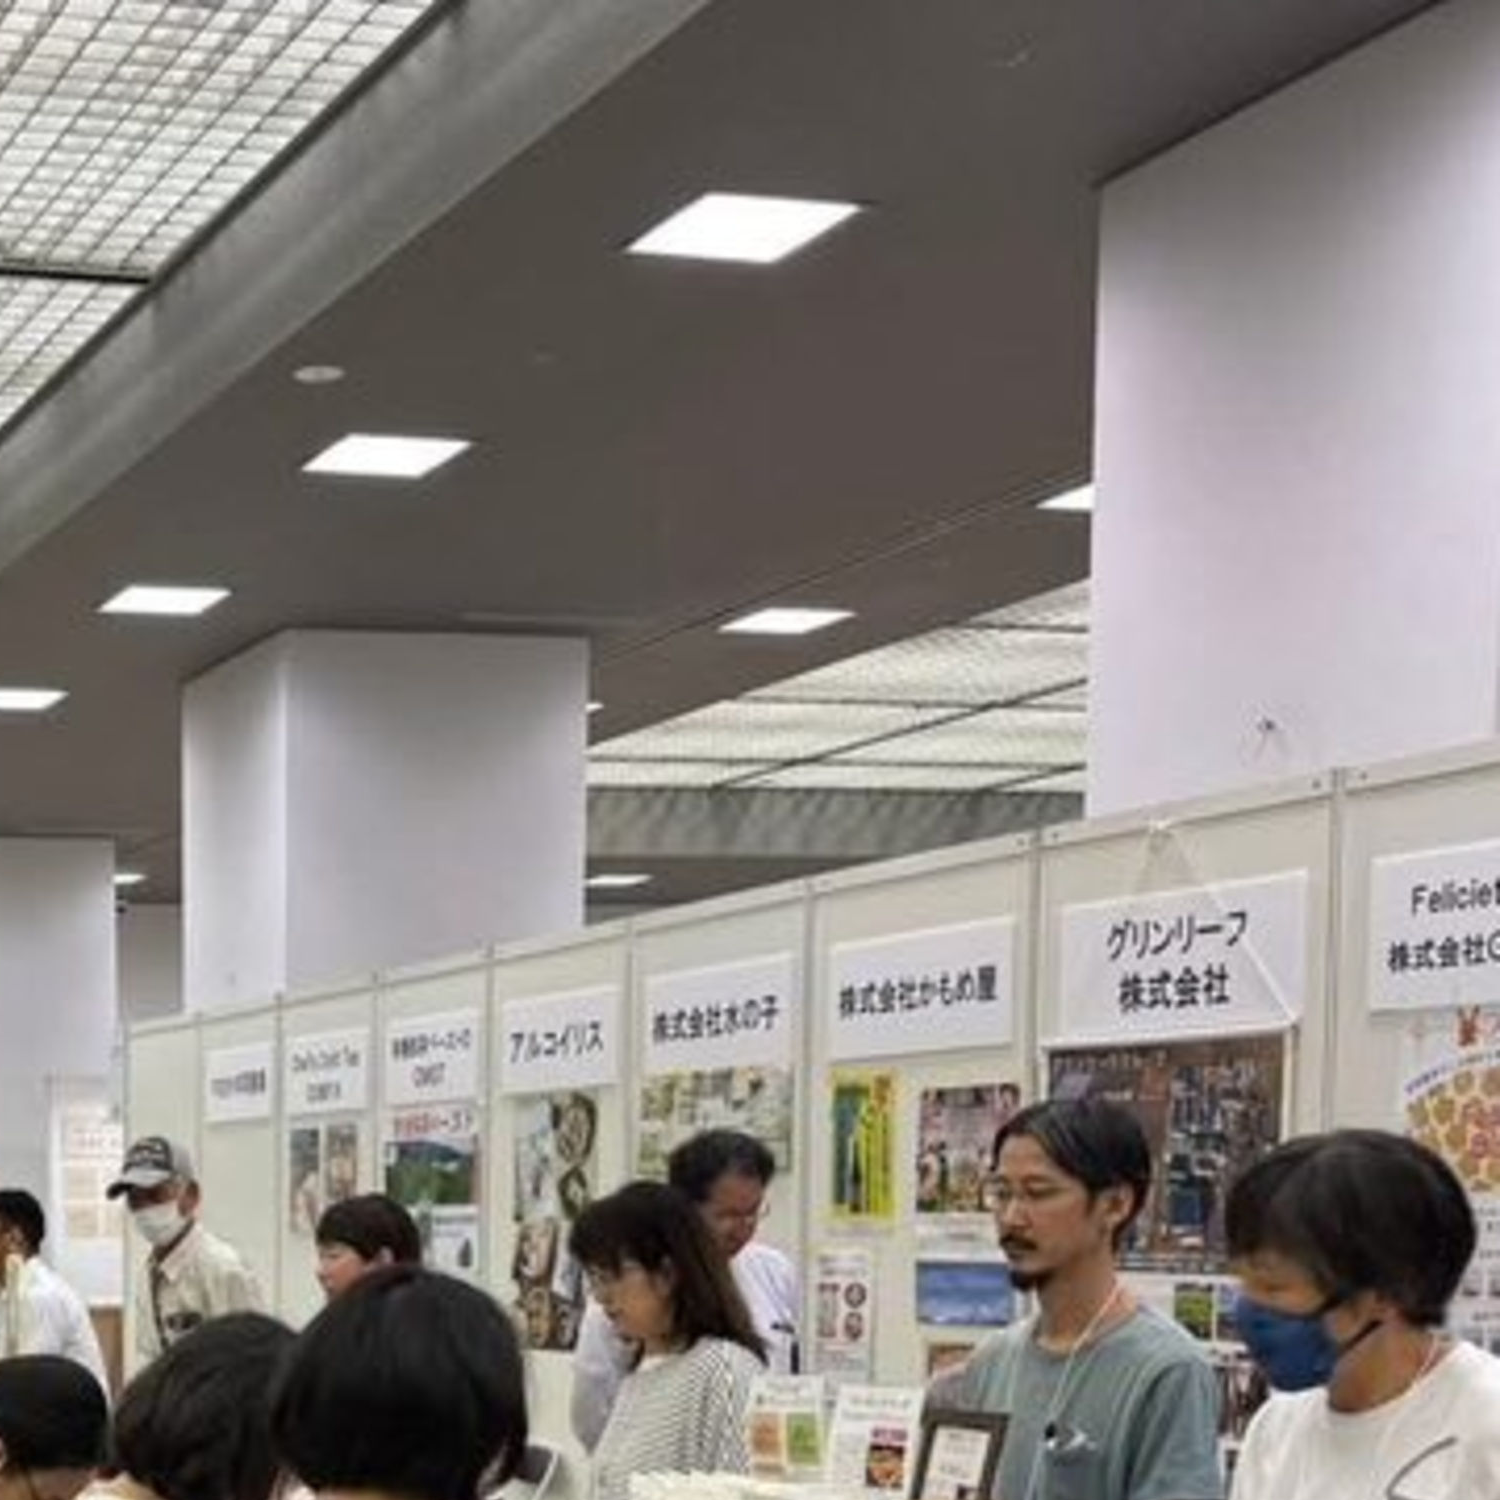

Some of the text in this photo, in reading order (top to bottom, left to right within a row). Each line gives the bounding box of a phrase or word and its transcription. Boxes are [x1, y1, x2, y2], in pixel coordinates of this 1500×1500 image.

[1409, 877, 1500, 917] Felicie
[1105, 910, 1248, 961] グリンリーフ
[838, 964, 998, 1020] 株式会社かもめ屋
[1117, 963, 1231, 1013] 株式会社
[509, 1020, 605, 1065] アルコイリス
